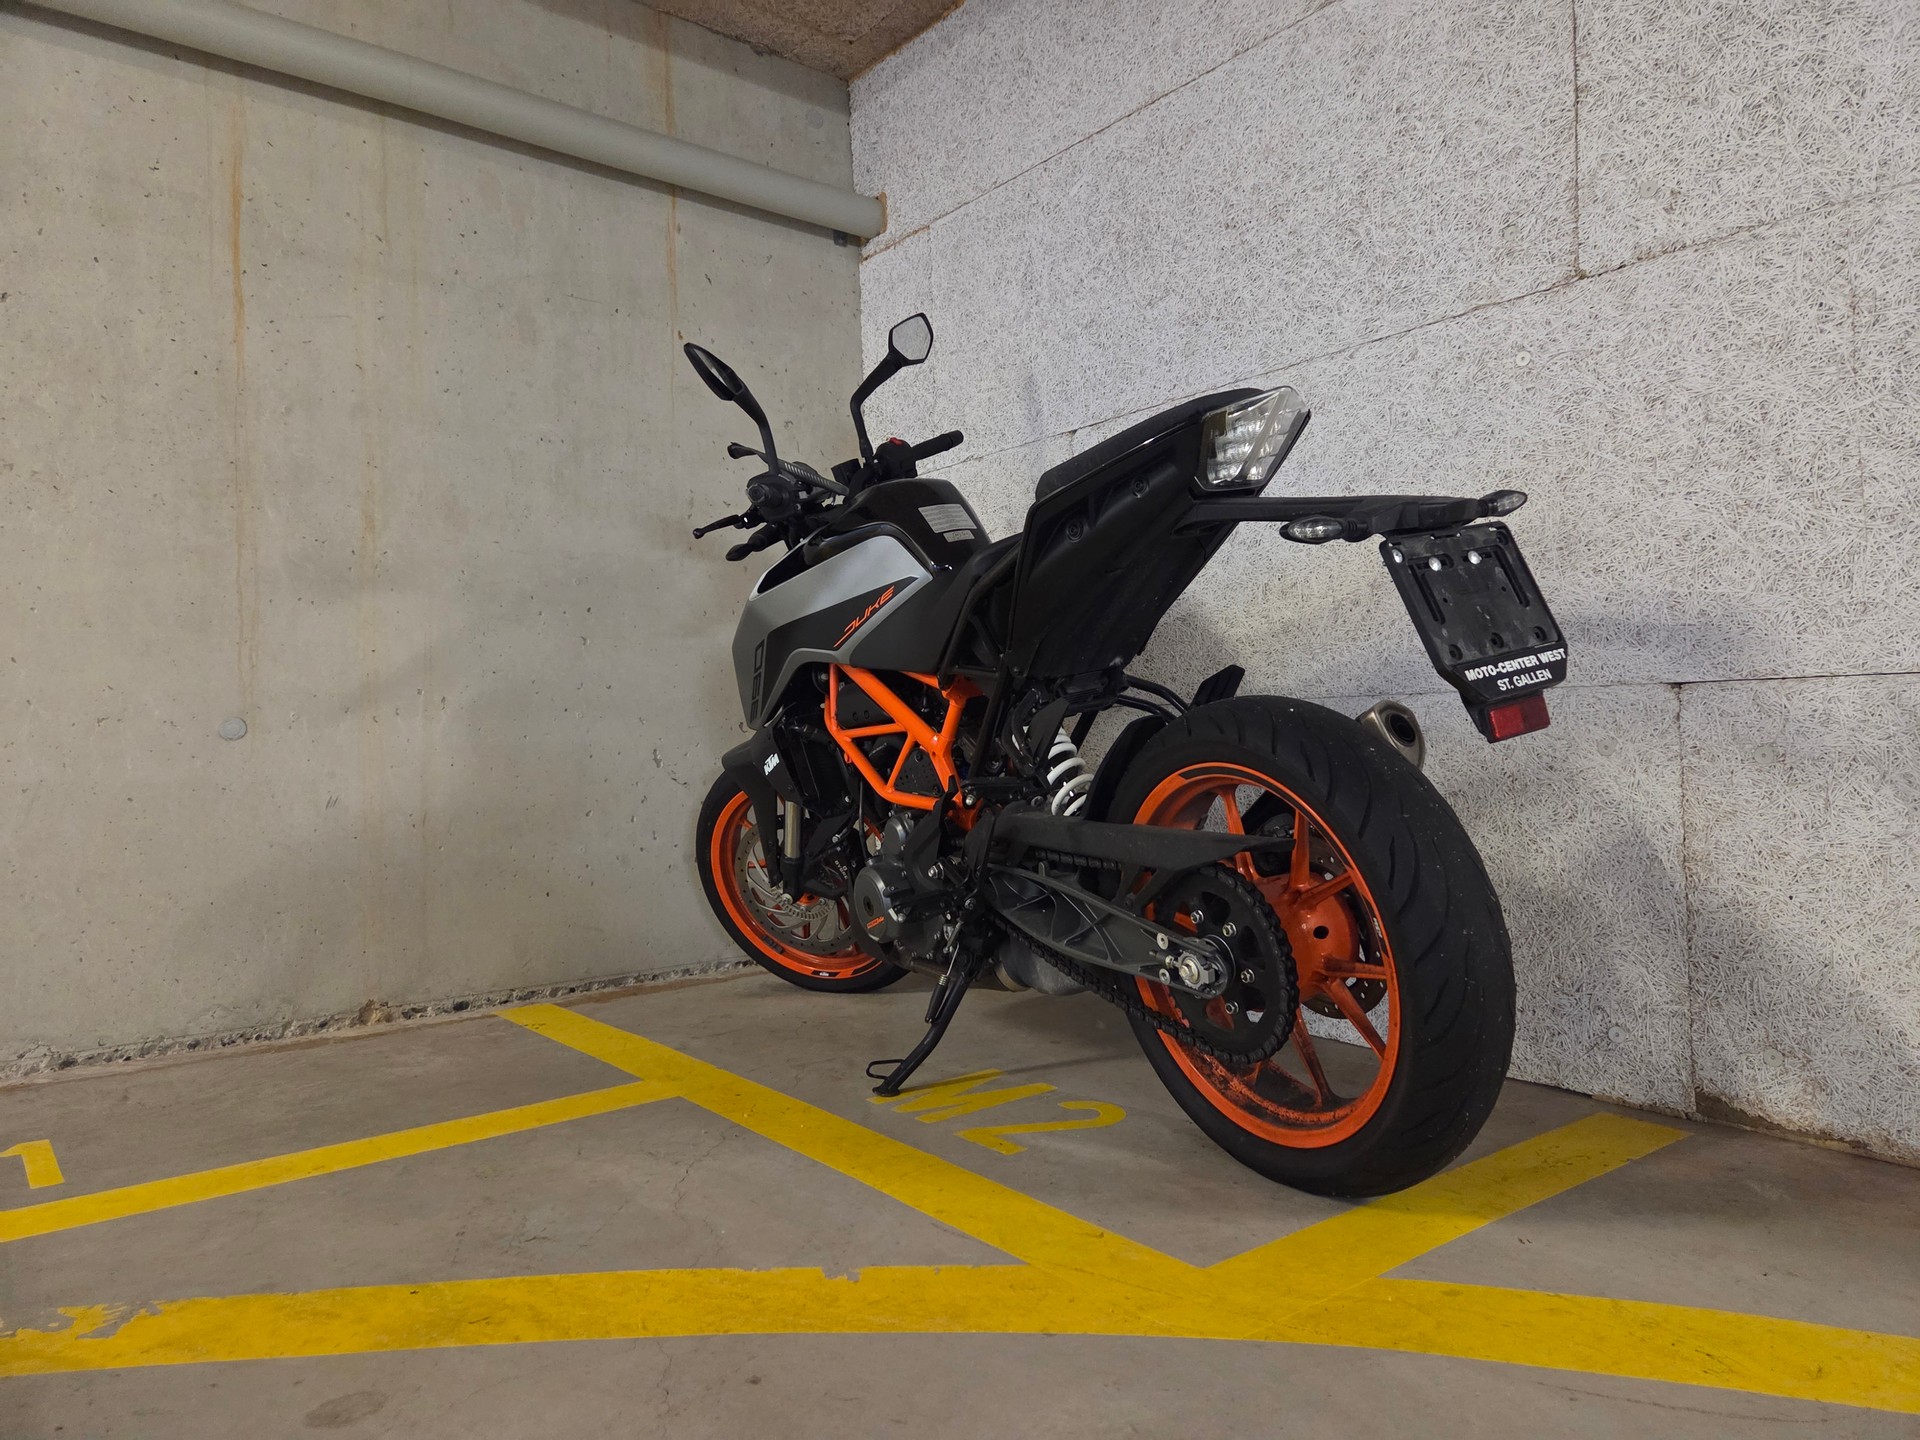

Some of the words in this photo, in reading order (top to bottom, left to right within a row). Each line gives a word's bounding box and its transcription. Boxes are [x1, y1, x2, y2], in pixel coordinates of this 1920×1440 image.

[833, 585, 895, 648] DUKE
[1464, 655, 1538, 682] MOTO-CENTER
[1539, 648, 1567, 666] WEST
[1497, 677, 1514, 692] ST.
[1514, 669, 1552, 688] GALLEN
[763, 753, 780, 776] KTM
